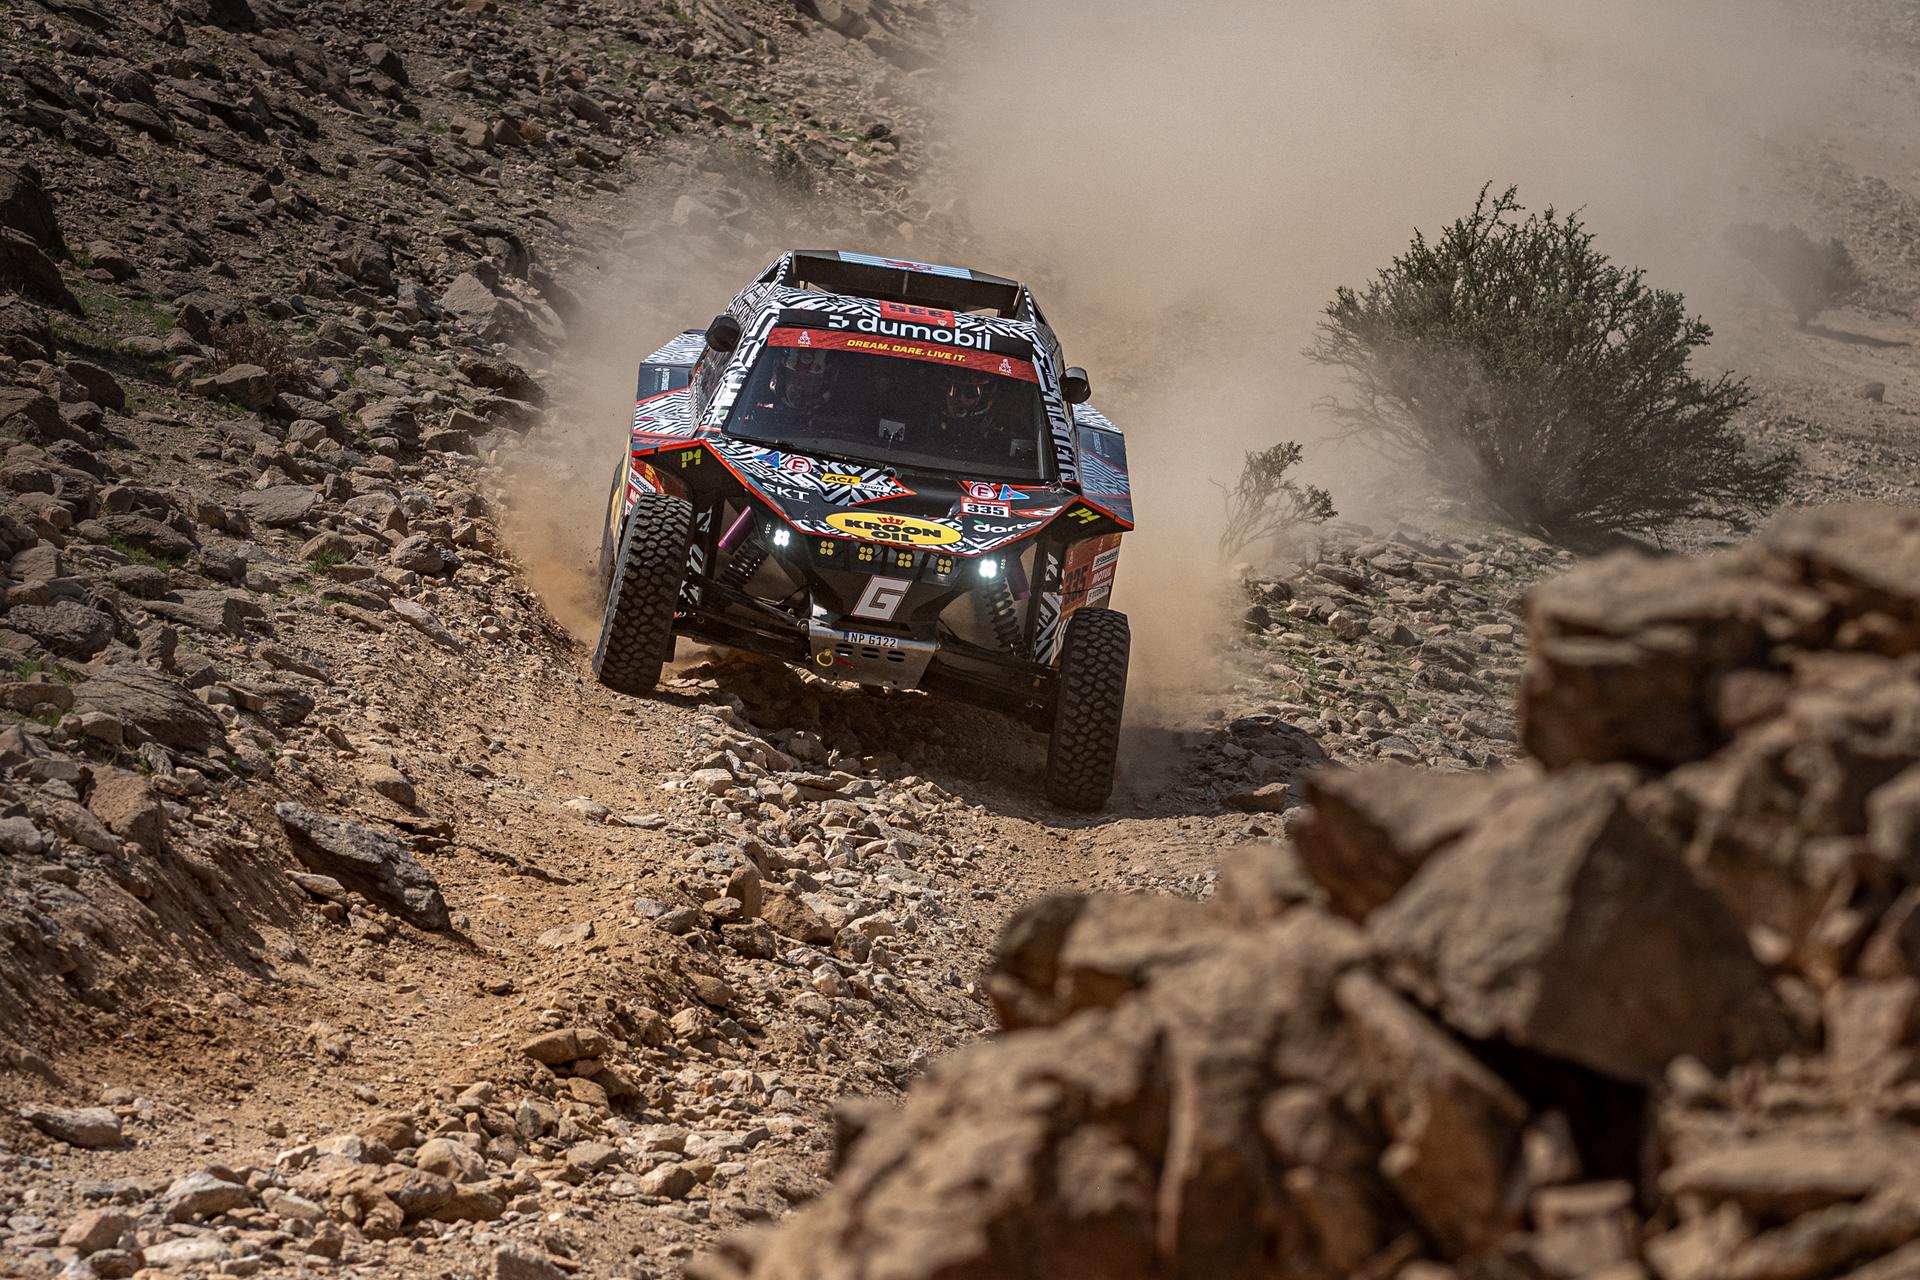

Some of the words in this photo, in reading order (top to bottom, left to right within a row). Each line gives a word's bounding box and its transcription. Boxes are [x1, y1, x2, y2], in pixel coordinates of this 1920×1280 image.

[857, 316, 991, 351] dumobil
[846, 339, 890, 351] DREAM.
[892, 345, 925, 356] DARE.
[926, 349, 953, 360] LIVE
[953, 353, 966, 362] IT.
[681, 448, 702, 469] P1
[791, 460, 806, 472] E
[825, 475, 858, 485] ACL
[859, 482, 885, 492] Sport
[761, 482, 810, 500] SKT
[977, 486, 989, 497] E
[967, 504, 1005, 516] 335
[1067, 507, 1101, 525] P1
[844, 518, 942, 539] KROON
[871, 530, 914, 543] OIL
[850, 574, 913, 622] G
[850, 632, 865, 643] NP
